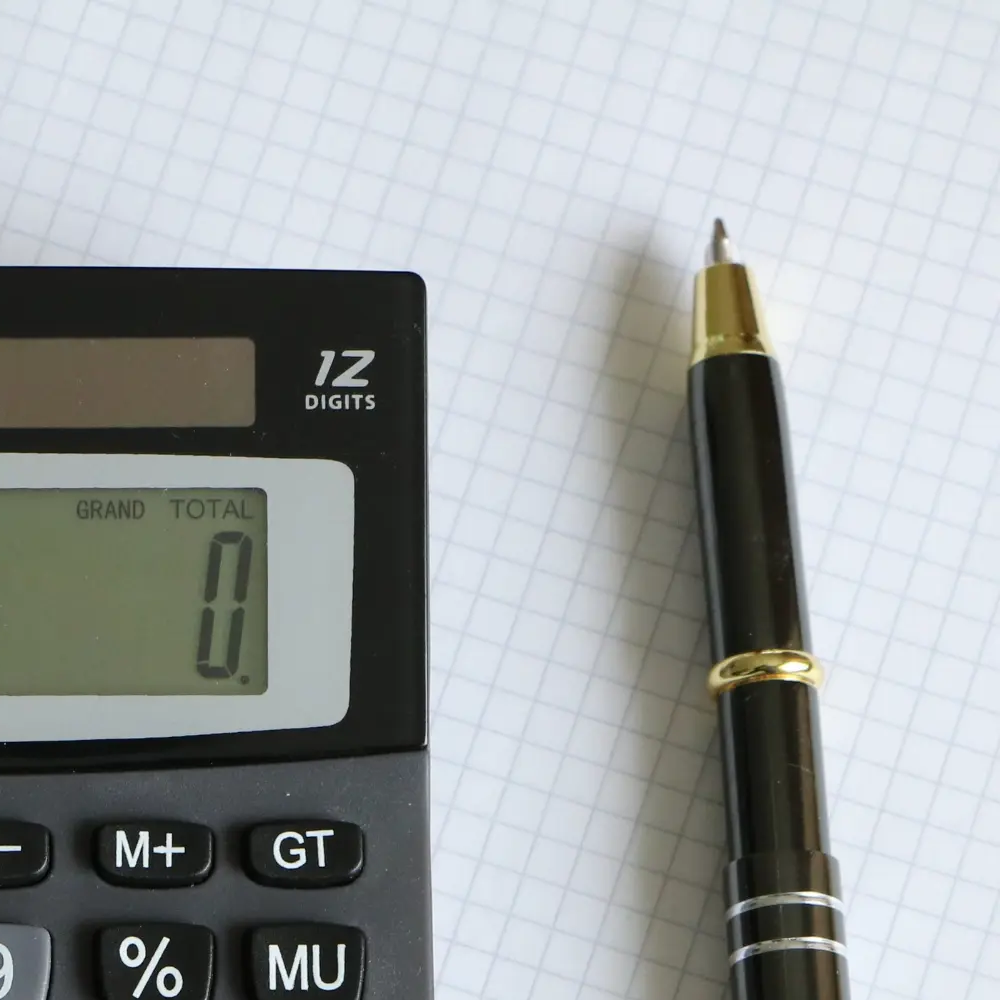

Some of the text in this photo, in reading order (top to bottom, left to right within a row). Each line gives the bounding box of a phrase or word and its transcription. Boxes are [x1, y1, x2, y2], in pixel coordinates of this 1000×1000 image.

[305, 394, 376, 410] DIGITS
[76, 499, 255, 520] GRAND TOTAL
[115, 830, 185, 868] M+
[273, 829, 334, 869] GT
[119, 936, 183, 999] %
[268, 943, 346, 991] MU
